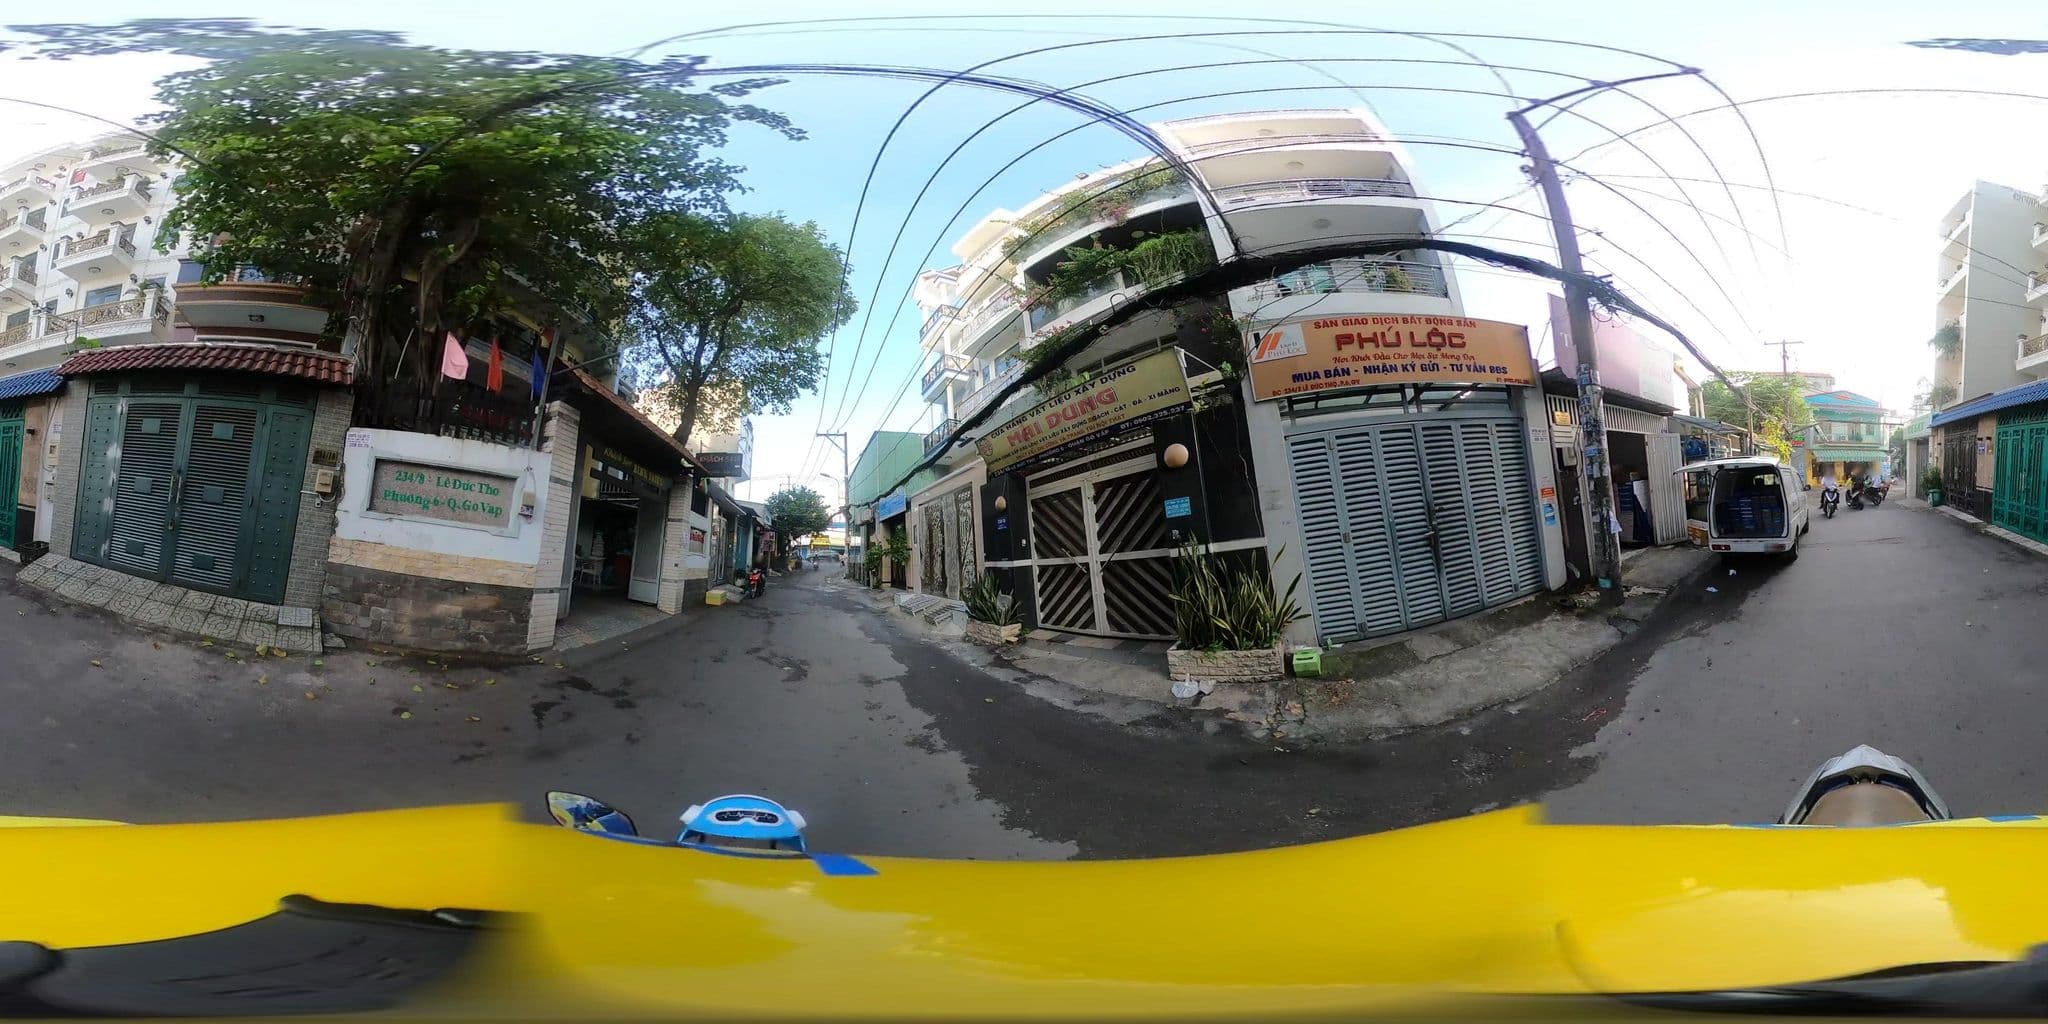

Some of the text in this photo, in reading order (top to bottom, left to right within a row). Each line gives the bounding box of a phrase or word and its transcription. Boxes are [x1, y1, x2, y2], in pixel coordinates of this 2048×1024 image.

[1342, 317, 1368, 326] GIAO
[1372, 317, 1399, 325] DỊCH
[1335, 325, 1467, 351] PHÚ LỘC
[1393, 352, 1409, 360] Cho
[1291, 371, 1321, 383] MUA
[1323, 366, 1351, 378] BÁN
[1363, 363, 1398, 376] NHẬN
[1401, 361, 1416, 372] KÝ
[1420, 360, 1440, 373] GỬI
[395, 471, 425, 485] 234/8
